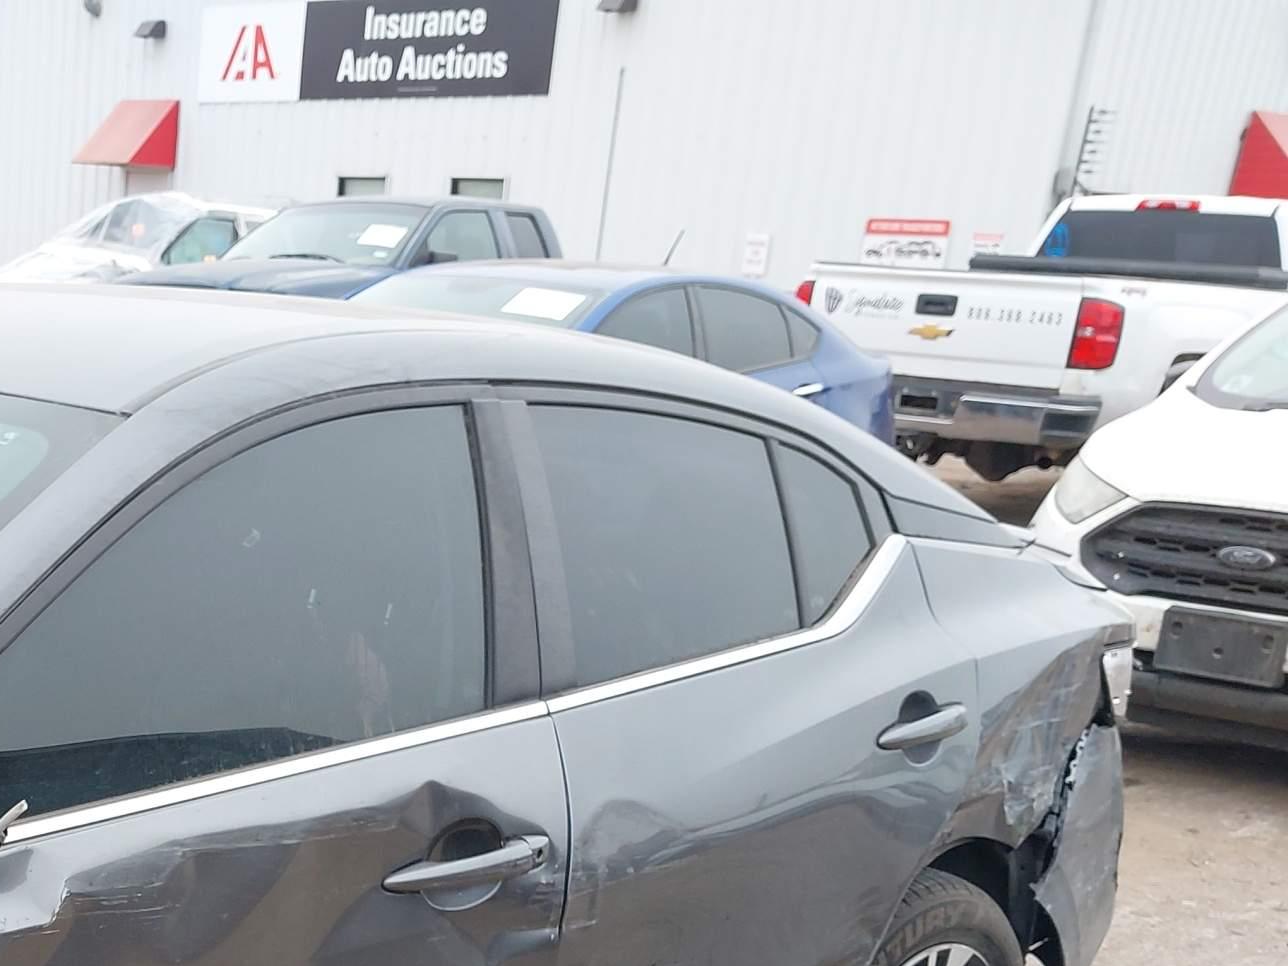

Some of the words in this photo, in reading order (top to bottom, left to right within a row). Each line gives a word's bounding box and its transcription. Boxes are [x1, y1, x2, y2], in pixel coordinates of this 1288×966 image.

[363, 5, 488, 41] Insurance
[335, 48, 394, 83] Auto
[395, 43, 509, 81] Auctions
